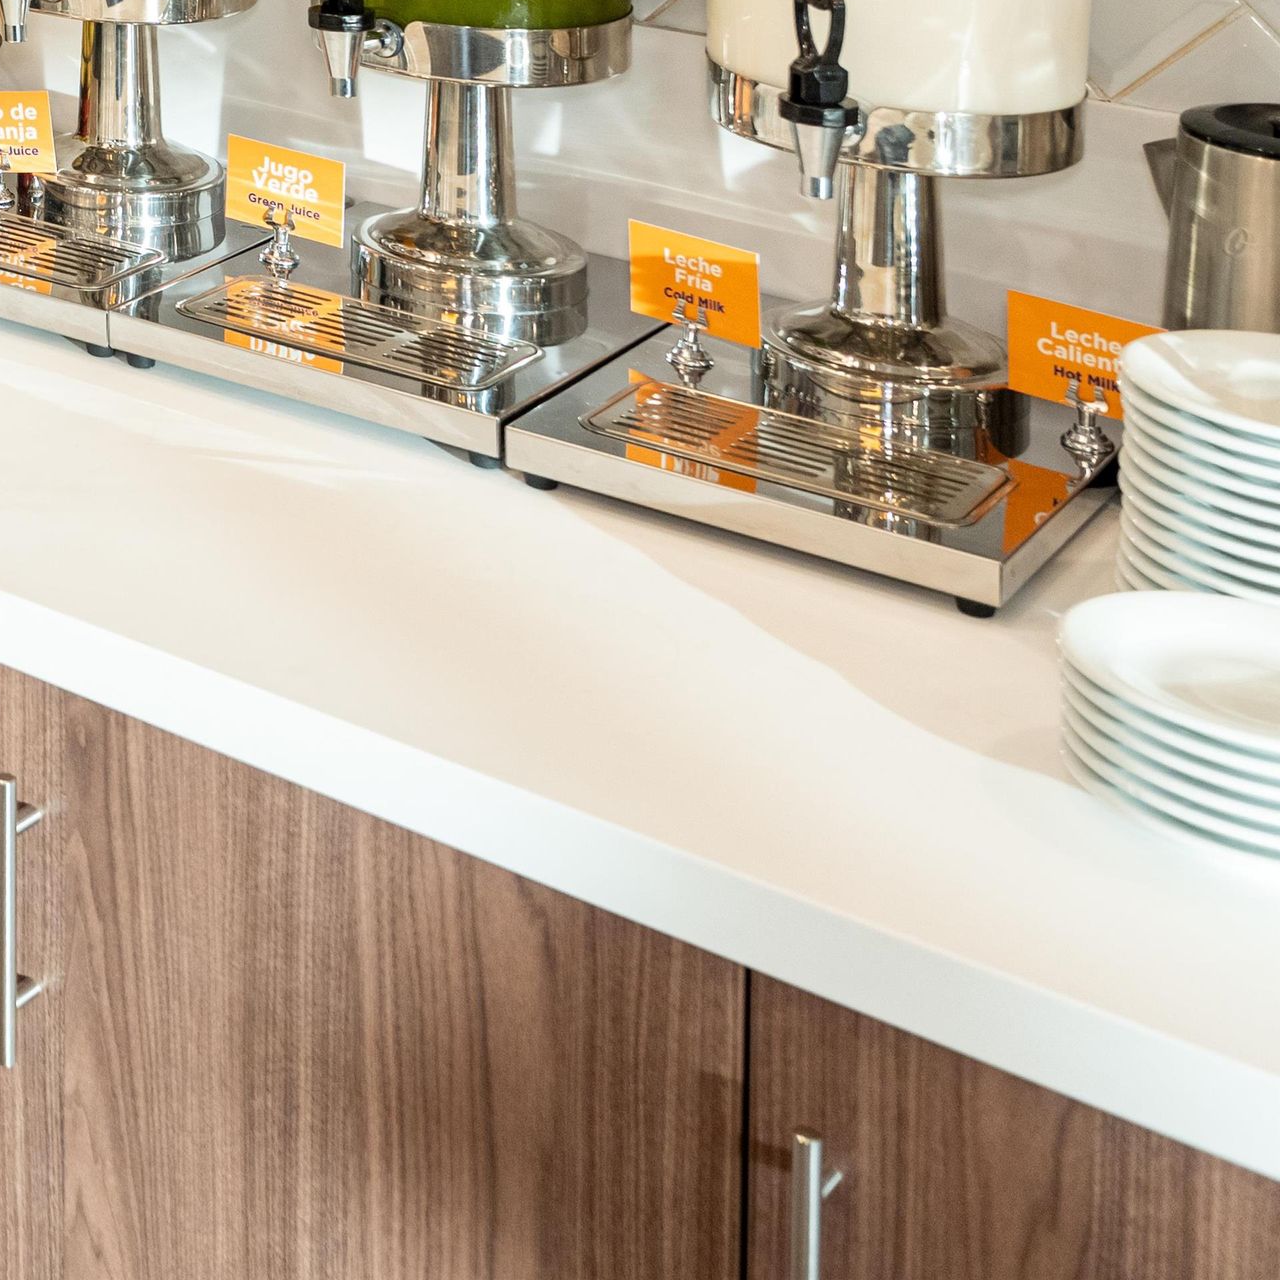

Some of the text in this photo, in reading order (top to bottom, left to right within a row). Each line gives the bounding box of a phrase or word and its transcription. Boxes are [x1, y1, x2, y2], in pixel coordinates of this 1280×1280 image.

[10, 102, 38, 121] de
[8, 145, 39, 156] Juice
[257, 156, 313, 185] Jugo
[251, 169, 319, 204] Verde
[248, 193, 284, 210] Green
[663, 247, 723, 278] Leche
[664, 287, 725, 313] Cold Milk
[1050, 321, 1121, 355] Leche
[1053, 365, 1120, 393] Hot Milk
